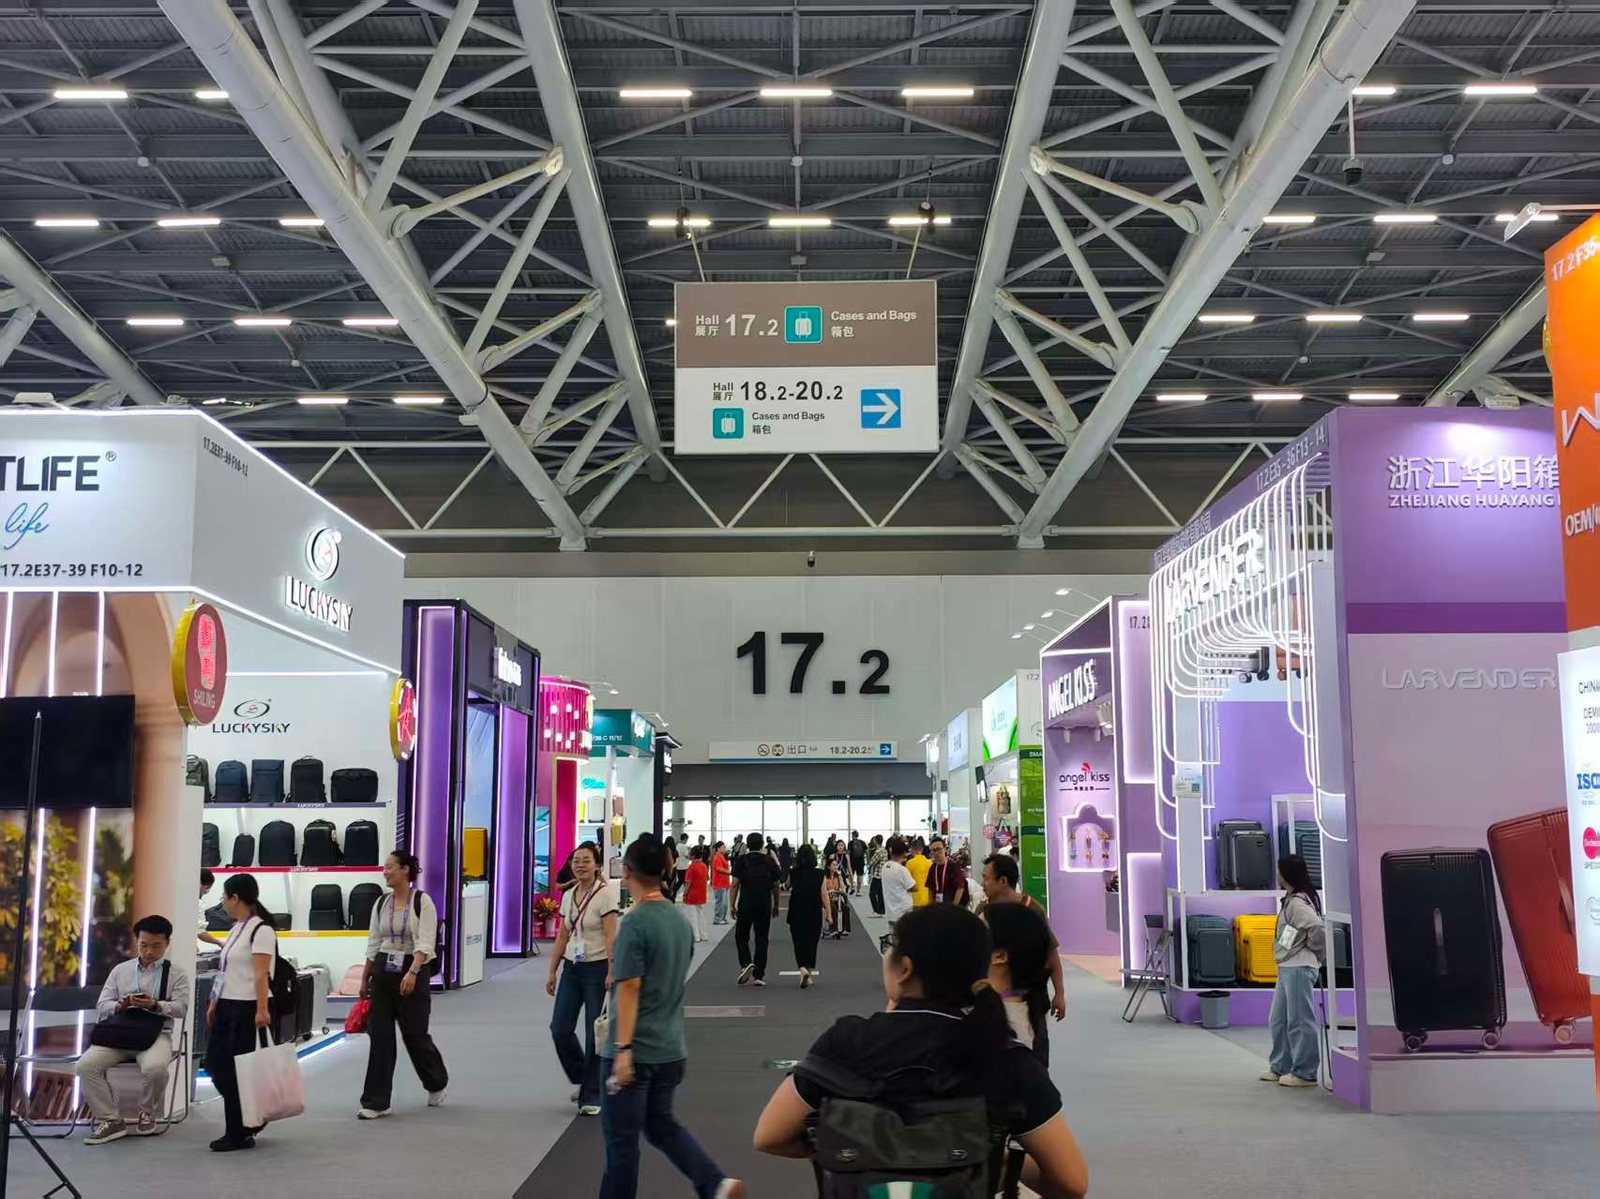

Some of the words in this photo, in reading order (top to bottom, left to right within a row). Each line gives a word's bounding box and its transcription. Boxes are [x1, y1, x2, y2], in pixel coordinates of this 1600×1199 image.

[831, 310, 864, 321] Cases
[866, 310, 887, 320] and
[889, 310, 917, 322] Bags
[695, 315, 720, 326] Hall
[725, 314, 778, 336] 17.2
[695, 326, 719, 336] 展厅
[831, 326, 855, 338] 箱包
[712, 392, 734, 401] 展厅
[713, 382, 734, 391] Hall
[740, 381, 843, 401] 18.2-20.2
[752, 412, 780, 420] Cases
[782, 411, 800, 420] and
[801, 412, 825, 422] Bags
[752, 424, 772, 434] 箱包
[1389, 494, 1472, 509] ZHEJIANG
[1476, 494, 1555, 508] HUAYANG
[4, 502, 49, 550] life
[0, 563, 86, 577] 17.2E37-39
[90, 563, 144, 577] F10-12
[286, 576, 353, 631] LUCKYSKY
[736, 631, 890, 695] 17.2
[1381, 666, 1558, 691] LARVENDER
[1048, 669, 1075, 720] ANGEL
[1073, 658, 1096, 706] KISS
[212, 723, 291, 734] LUCKYSKY
[787, 745, 807, 754] 出口
[1059, 771, 1087, 786] angel
[1091, 772, 1110, 782] kiss
